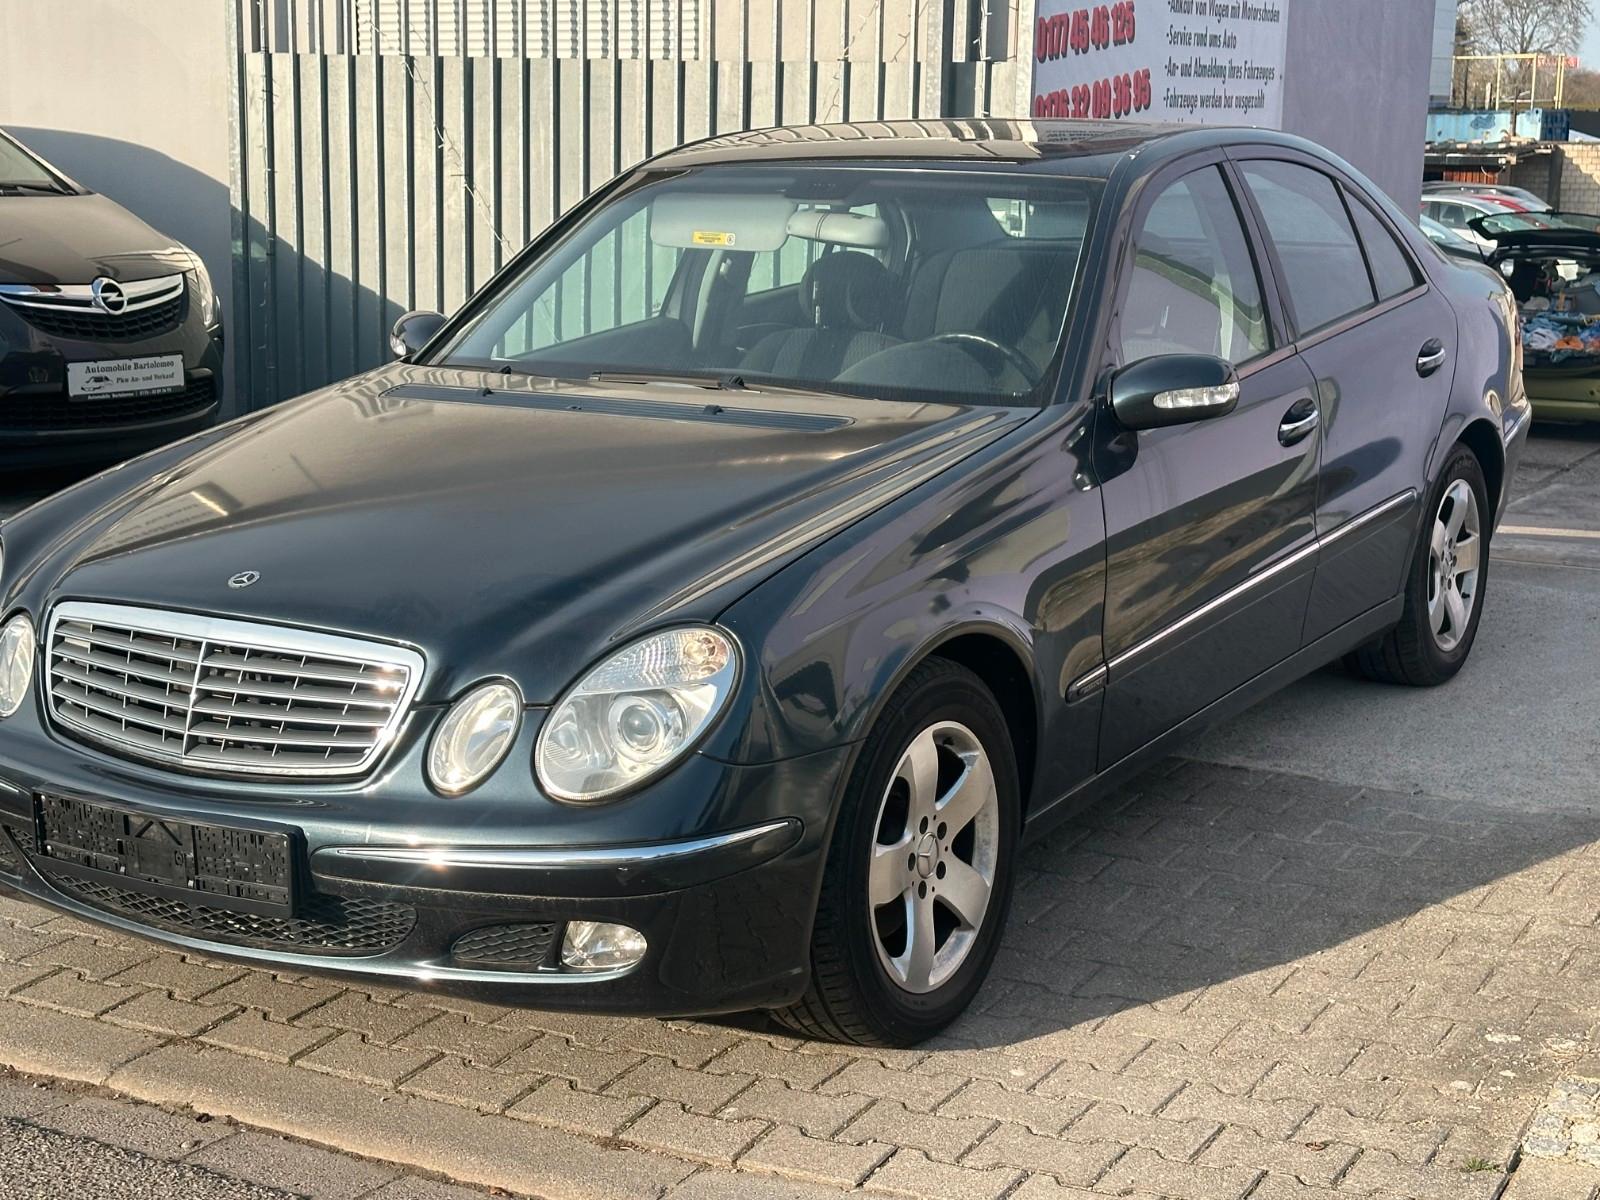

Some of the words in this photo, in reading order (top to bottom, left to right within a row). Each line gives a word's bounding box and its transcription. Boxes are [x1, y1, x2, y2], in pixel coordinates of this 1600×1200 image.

[1195, 1, 1207, 16] von
[1208, 0, 1229, 23] Wagen
[1230, 0, 1240, 19] mit
[1241, 0, 1280, 23] Motorschaden
[1037, 13, 1069, 64] 0177
[1070, 9, 1089, 56] 45
[1091, 5, 1109, 51] 46
[1111, 1, 1135, 47] 125
[1193, 25, 1208, 47] rund
[1208, 33, 1221, 48] ums
[1222, 28, 1237, 49] Auto
[1180, 56, 1192, 77] und
[1193, 56, 1227, 84] Abmeldung
[1228, 58, 1242, 79] ihres
[1243, 59, 1275, 86] Fahrzeuges
[1071, 83, 1090, 118] 32
[1092, 78, 1111, 119] 09
[1113, 73, 1132, 119] 36
[1132, 68, 1151, 113] 95
[1199, 88, 1222, 109] werden
[1223, 88, 1233, 109] bar
[1234, 88, 1265, 114] ausgezahlt
[85, 363, 131, 374] Automobile
[133, 360, 175, 371] Bartolomeo
[154, 372, 175, 380] Verkauf
